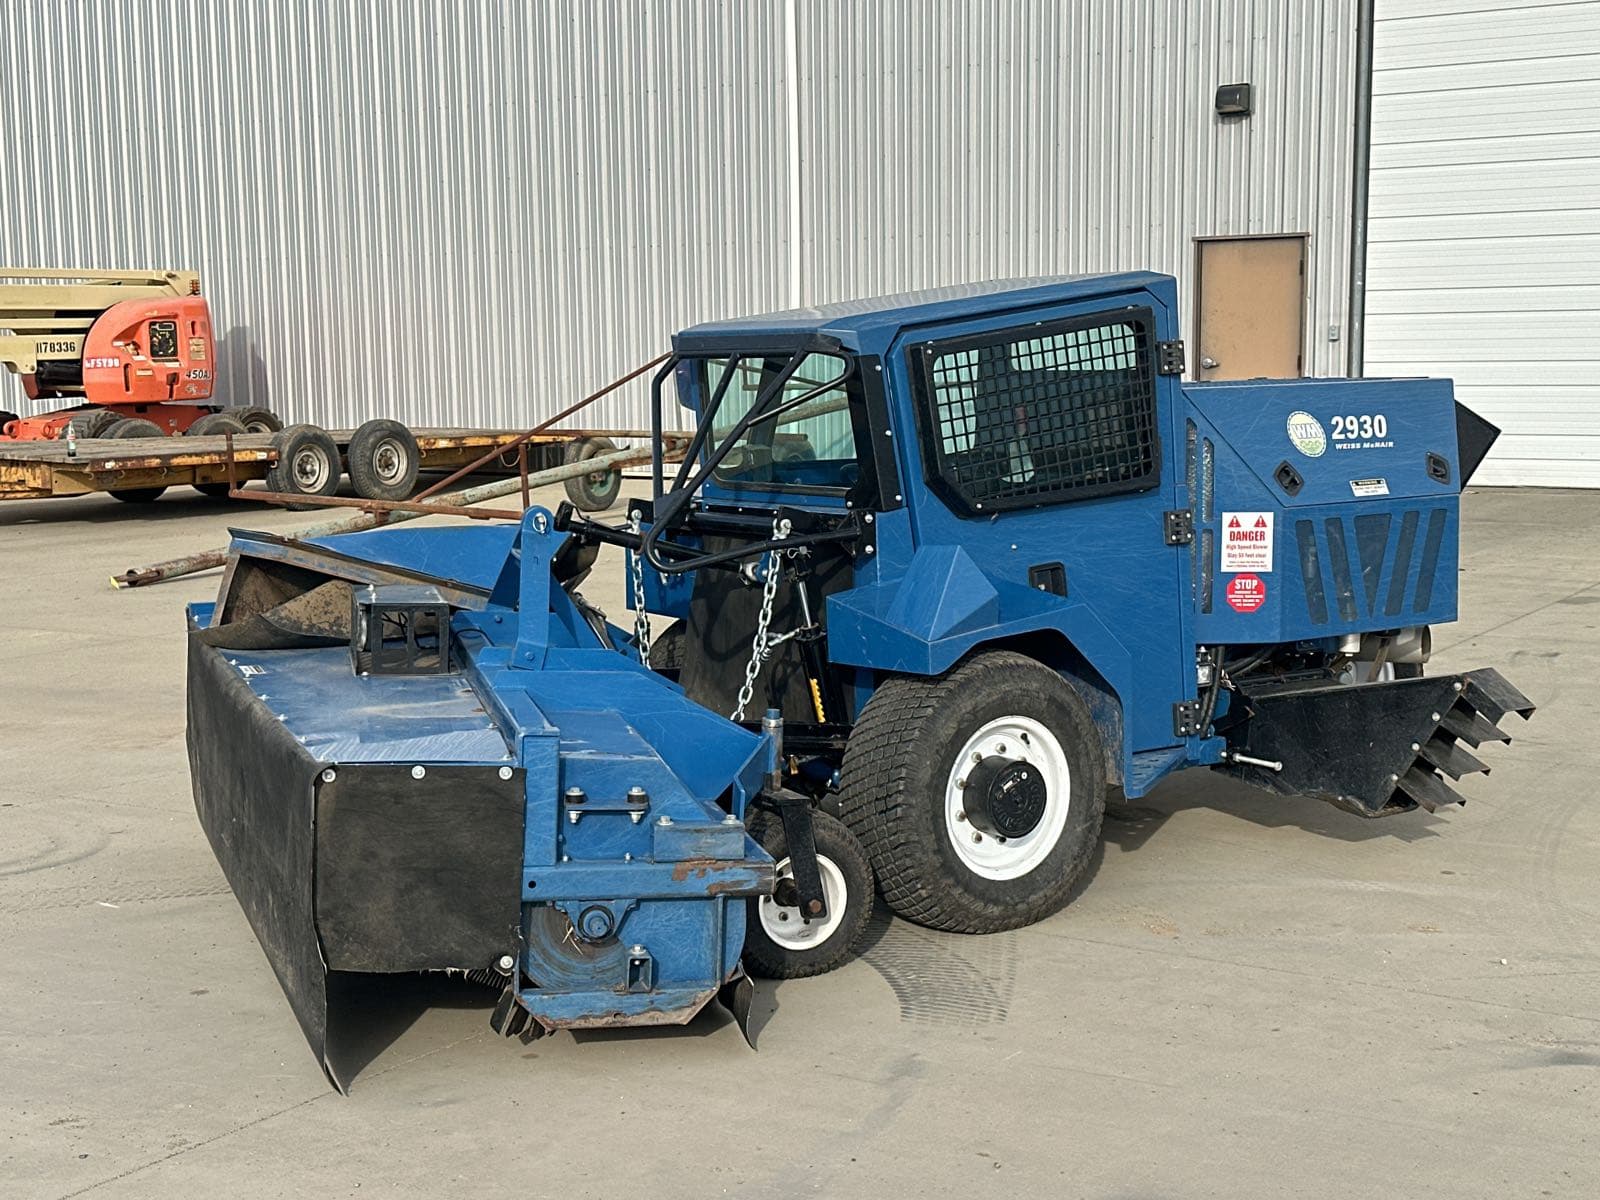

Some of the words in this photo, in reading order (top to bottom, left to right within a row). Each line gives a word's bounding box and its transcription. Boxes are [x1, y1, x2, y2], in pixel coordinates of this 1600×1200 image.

[1331, 414, 1387, 440] 2930
[1335, 442, 1361, 450] WEISS
[1229, 530, 1266, 542] DANGER
[1234, 579, 1258, 590] STOP
